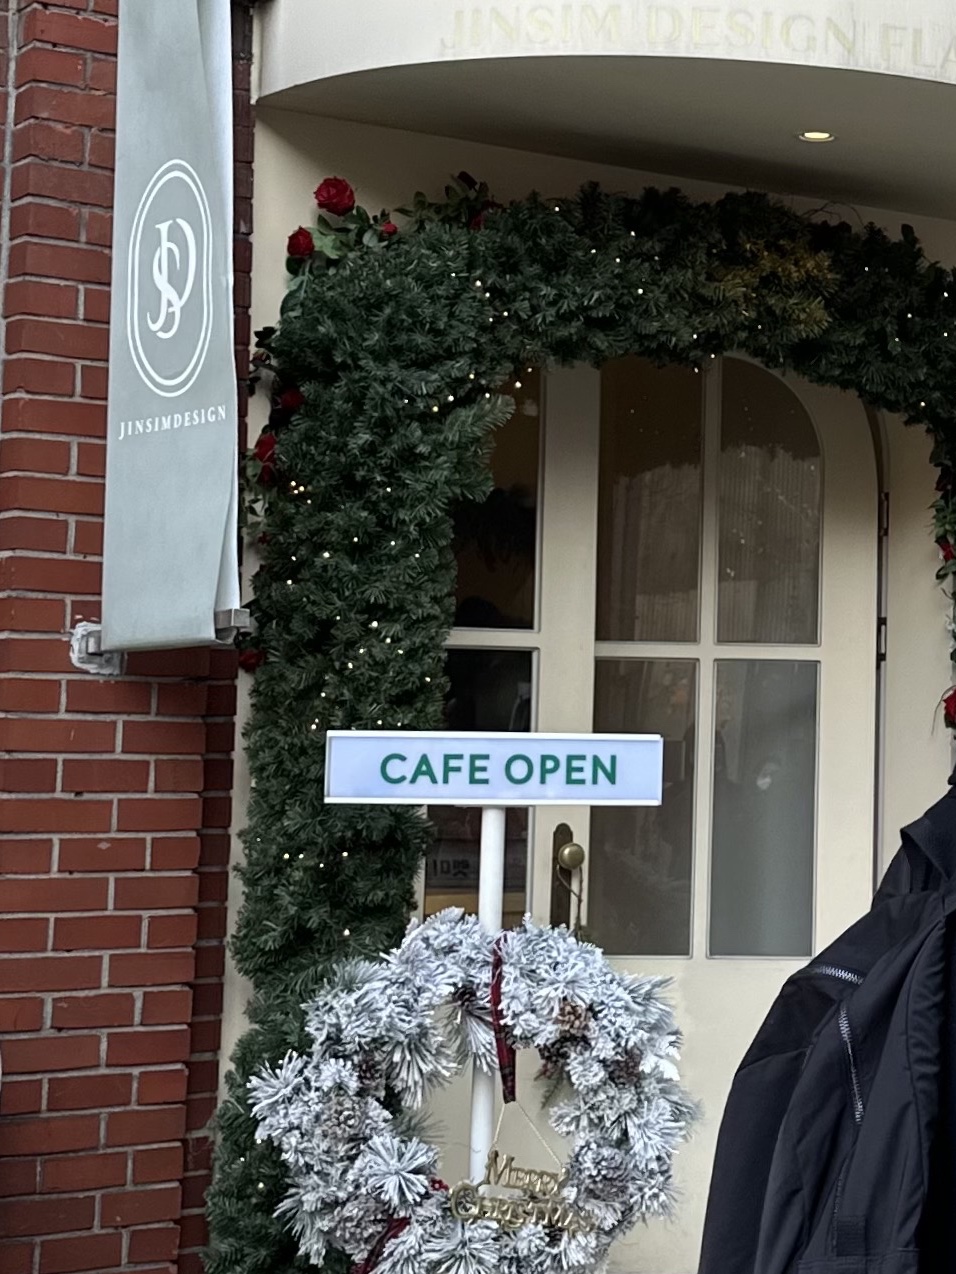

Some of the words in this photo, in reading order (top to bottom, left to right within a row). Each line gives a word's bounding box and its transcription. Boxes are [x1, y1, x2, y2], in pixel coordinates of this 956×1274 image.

[441, 4, 621, 50] JINSIM
[647, 5, 857, 58] DESIGN
[119, 405, 226, 440] JINSIMDESIGN
[380, 753, 490, 784] CAFE
[505, 754, 617, 785] OPEN
